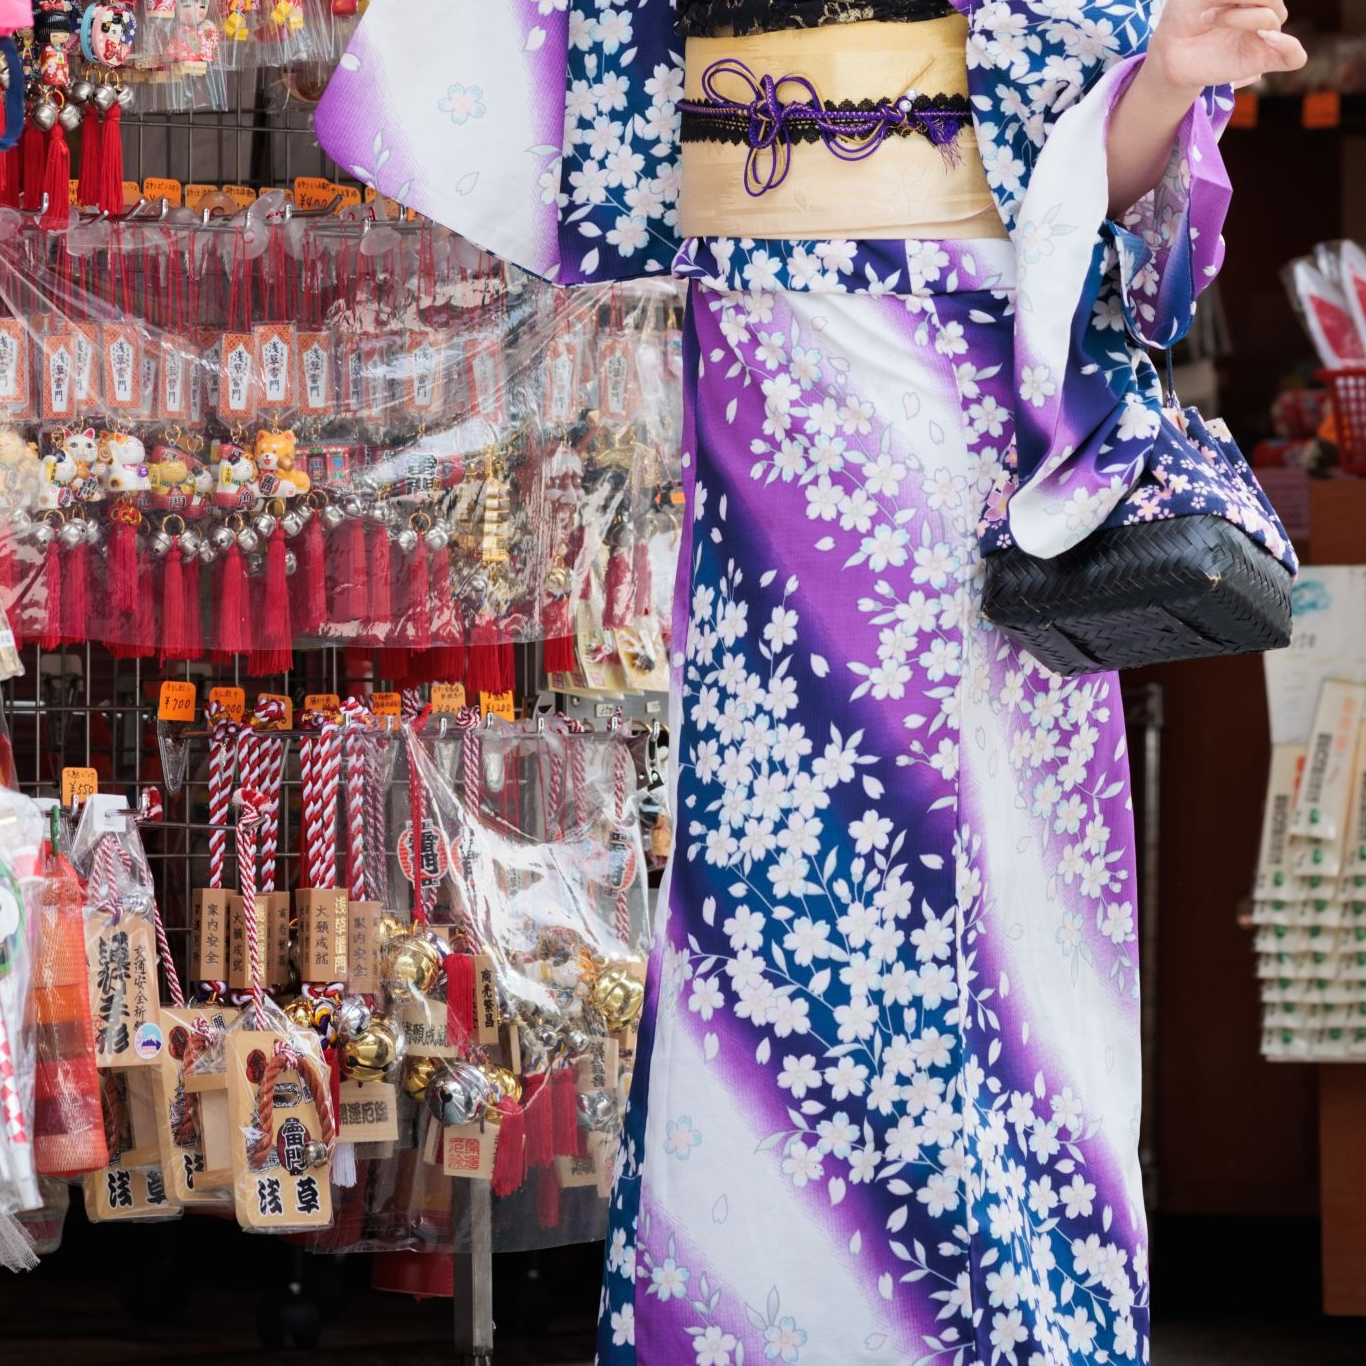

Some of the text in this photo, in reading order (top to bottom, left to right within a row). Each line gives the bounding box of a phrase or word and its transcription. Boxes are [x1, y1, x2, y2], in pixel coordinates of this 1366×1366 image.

[298, 194, 328, 208] ¥400
[115, 340, 128, 392] 浅草雷門
[268, 340, 281, 392] 浅草雷門
[308, 347, 321, 398] 浅草雷門
[164, 695, 192, 711] ¥700
[70, 781, 95, 795] ¥550
[205, 903, 221, 965] 家内安全
[314, 904, 330, 967] 大願成就
[352, 916, 368, 978] 家内安全
[284, 1123, 307, 1170] 雷門
[258, 1175, 321, 1216] 浅草
